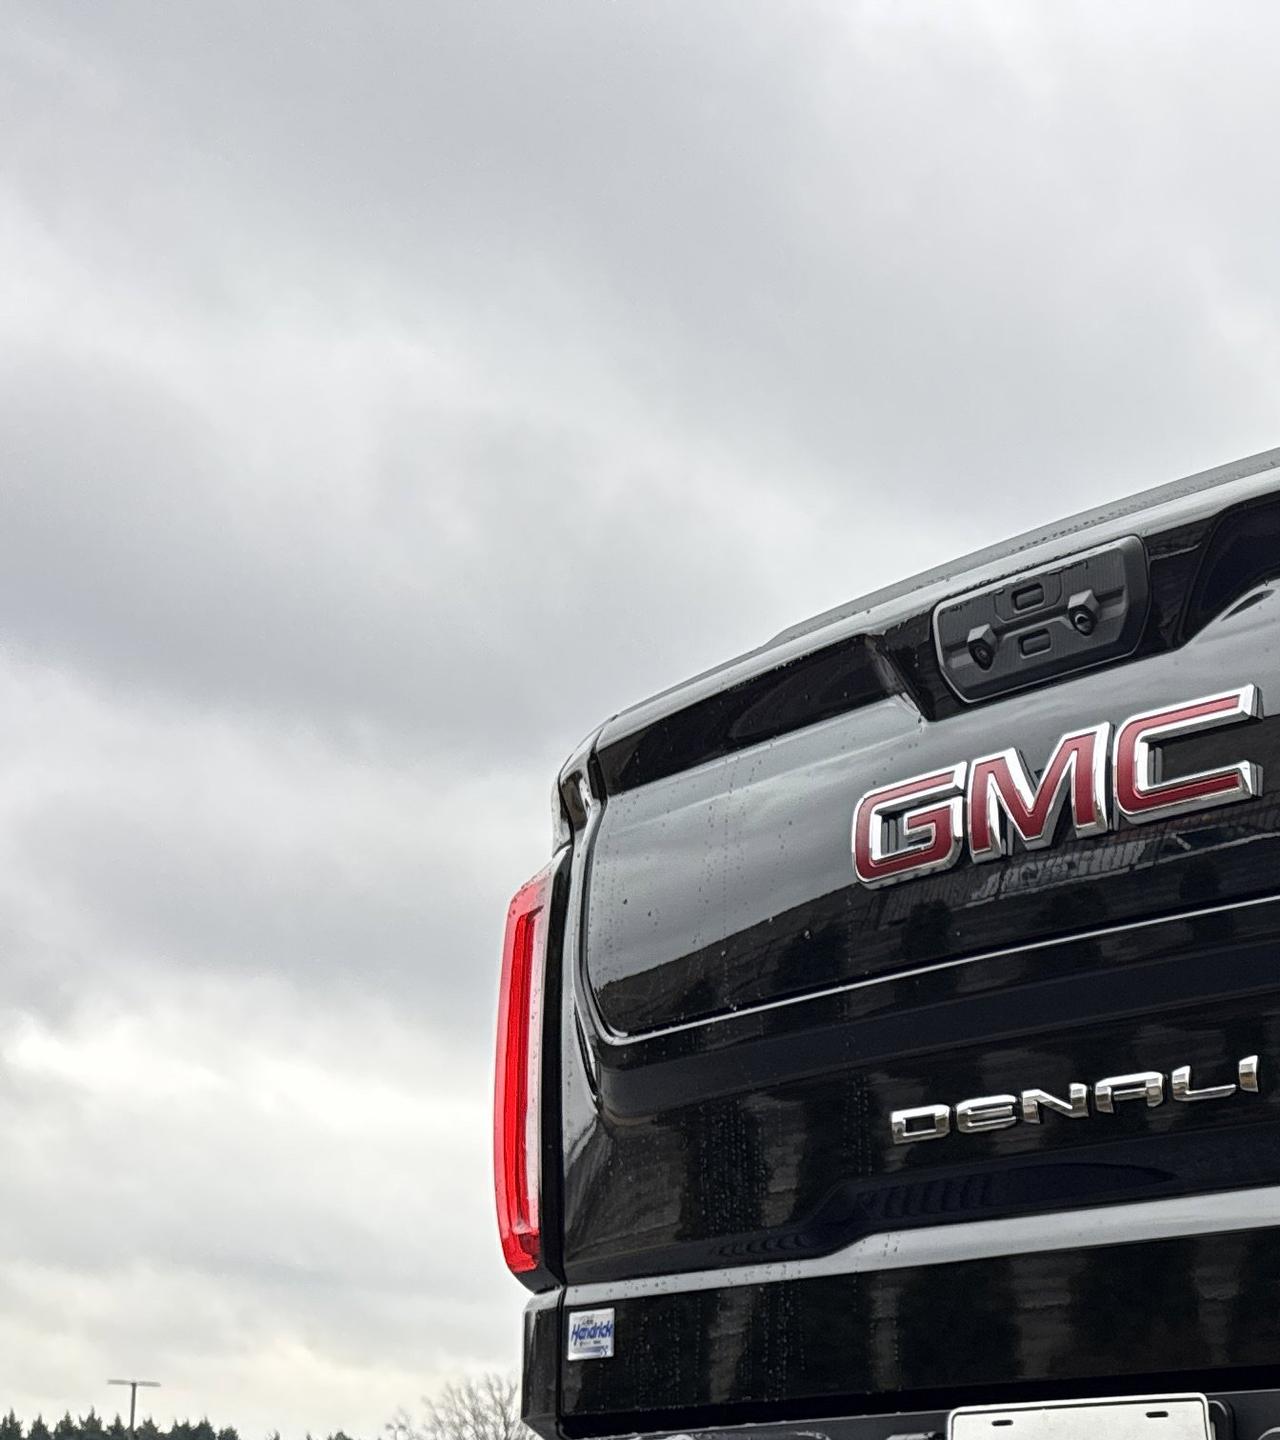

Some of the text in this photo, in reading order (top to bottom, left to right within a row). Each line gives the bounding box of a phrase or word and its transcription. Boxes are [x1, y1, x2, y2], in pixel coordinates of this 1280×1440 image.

[852, 684, 1263, 889] GMC
[891, 1055, 1259, 1144] DENALI
[571, 1320, 613, 1346] Hendrick
